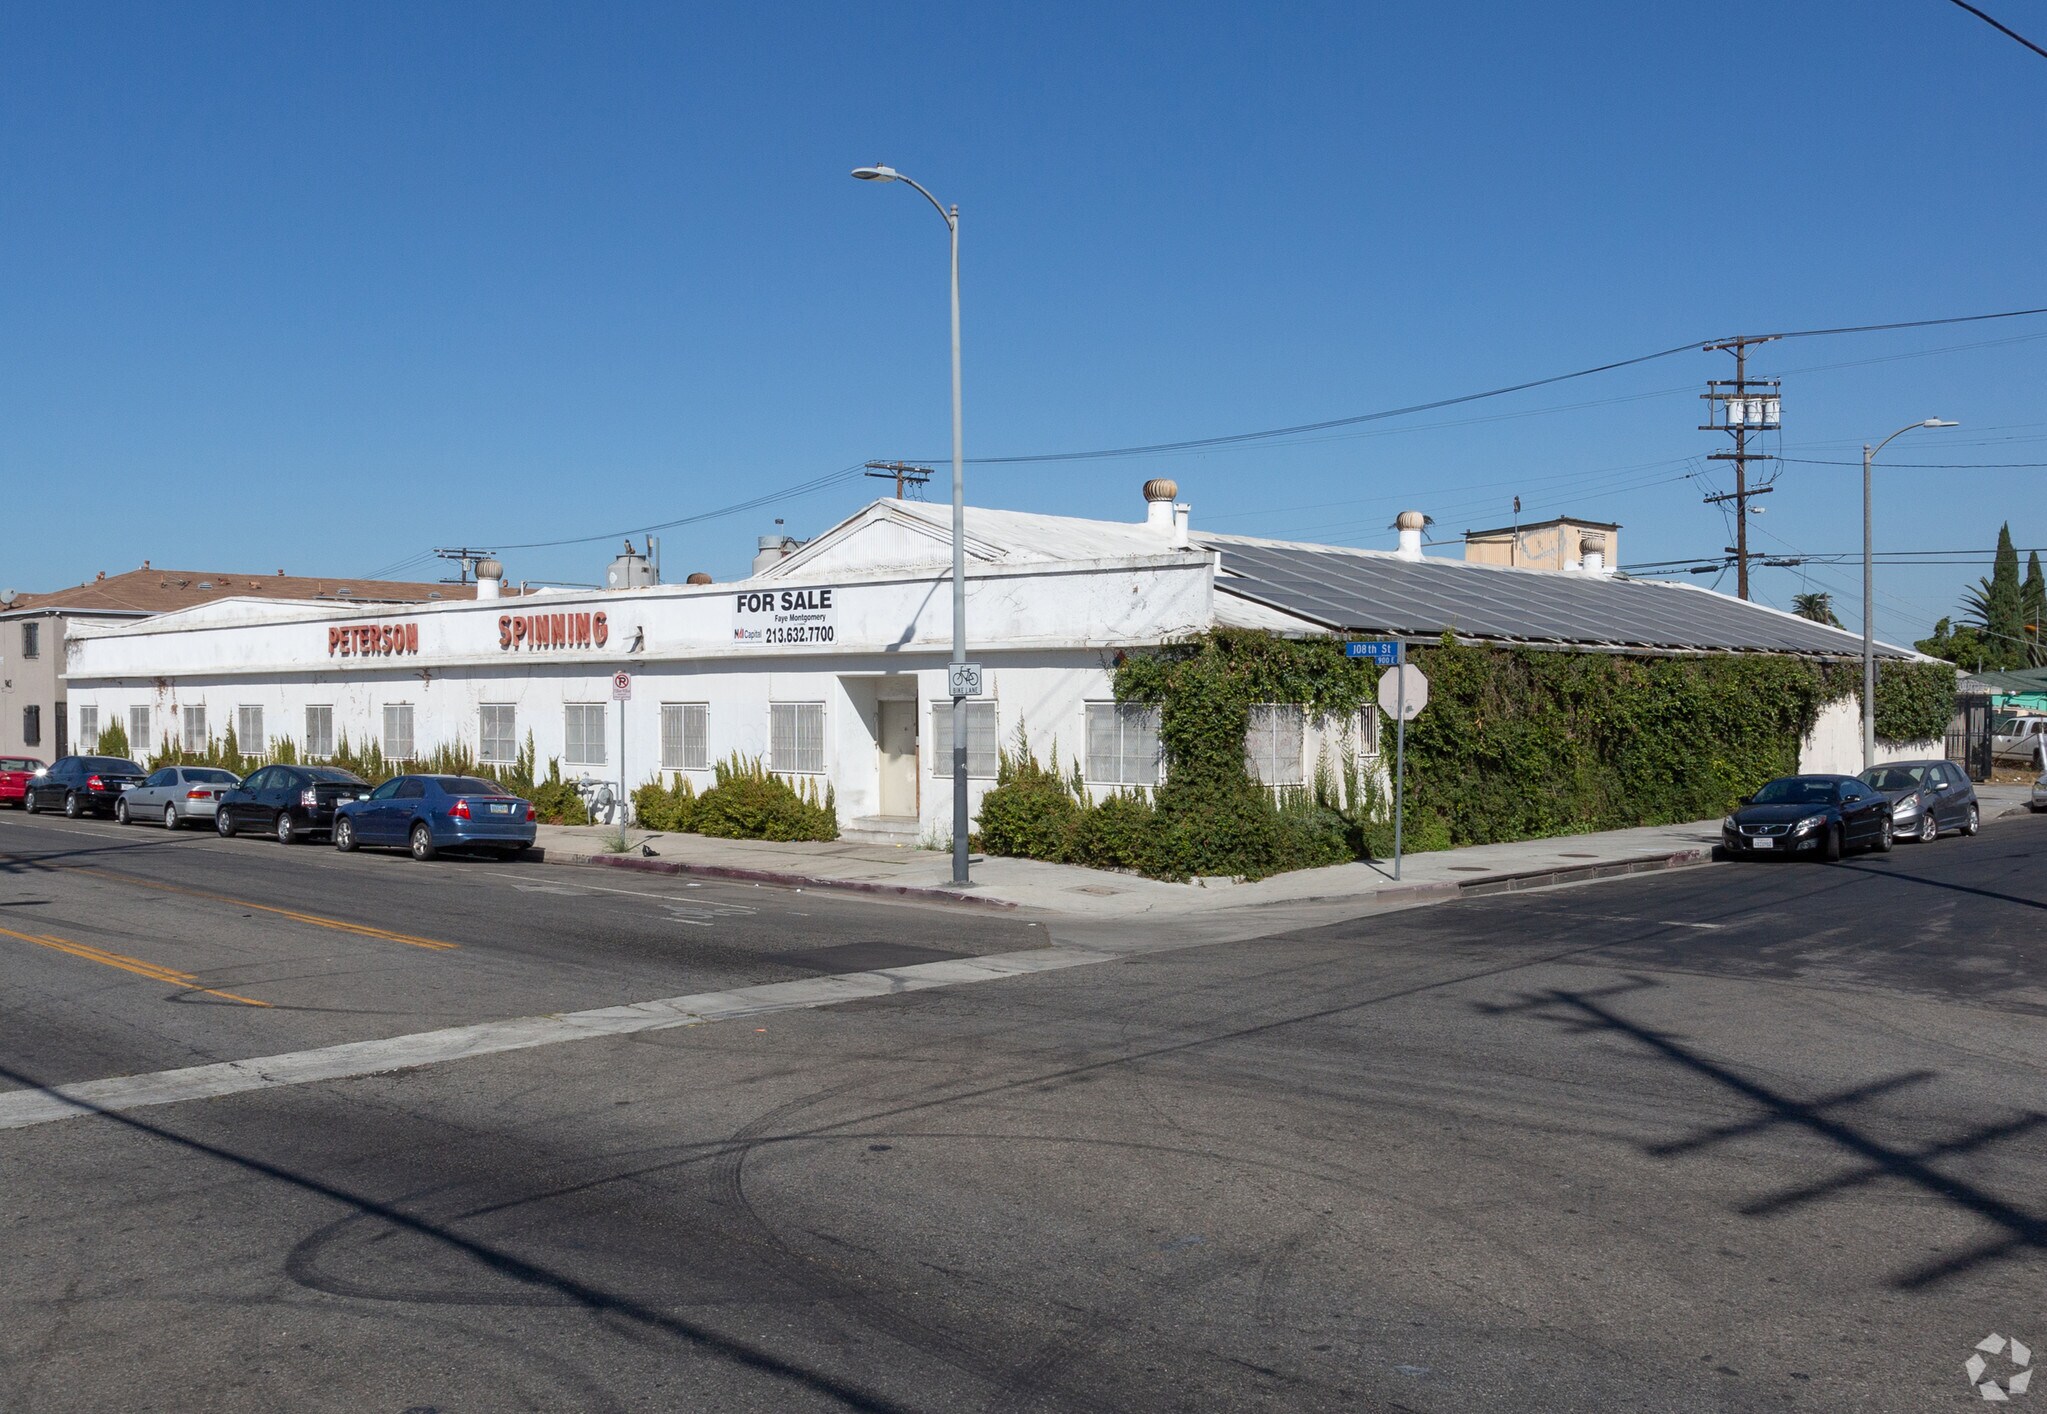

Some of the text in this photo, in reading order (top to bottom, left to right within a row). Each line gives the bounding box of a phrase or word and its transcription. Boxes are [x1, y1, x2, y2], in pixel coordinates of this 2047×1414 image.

[737, 590, 832, 613] FOR SALE
[774, 614, 826, 623] Faye Montgomery
[498, 611, 609, 651] SPINNING
[745, 629, 762, 640] Capital
[766, 625, 834, 643] 213.632.7700
[328, 623, 419, 657] PETERSON
[1352, 643, 1391, 655] 108th St
[1378, 656, 1390, 664] 900
